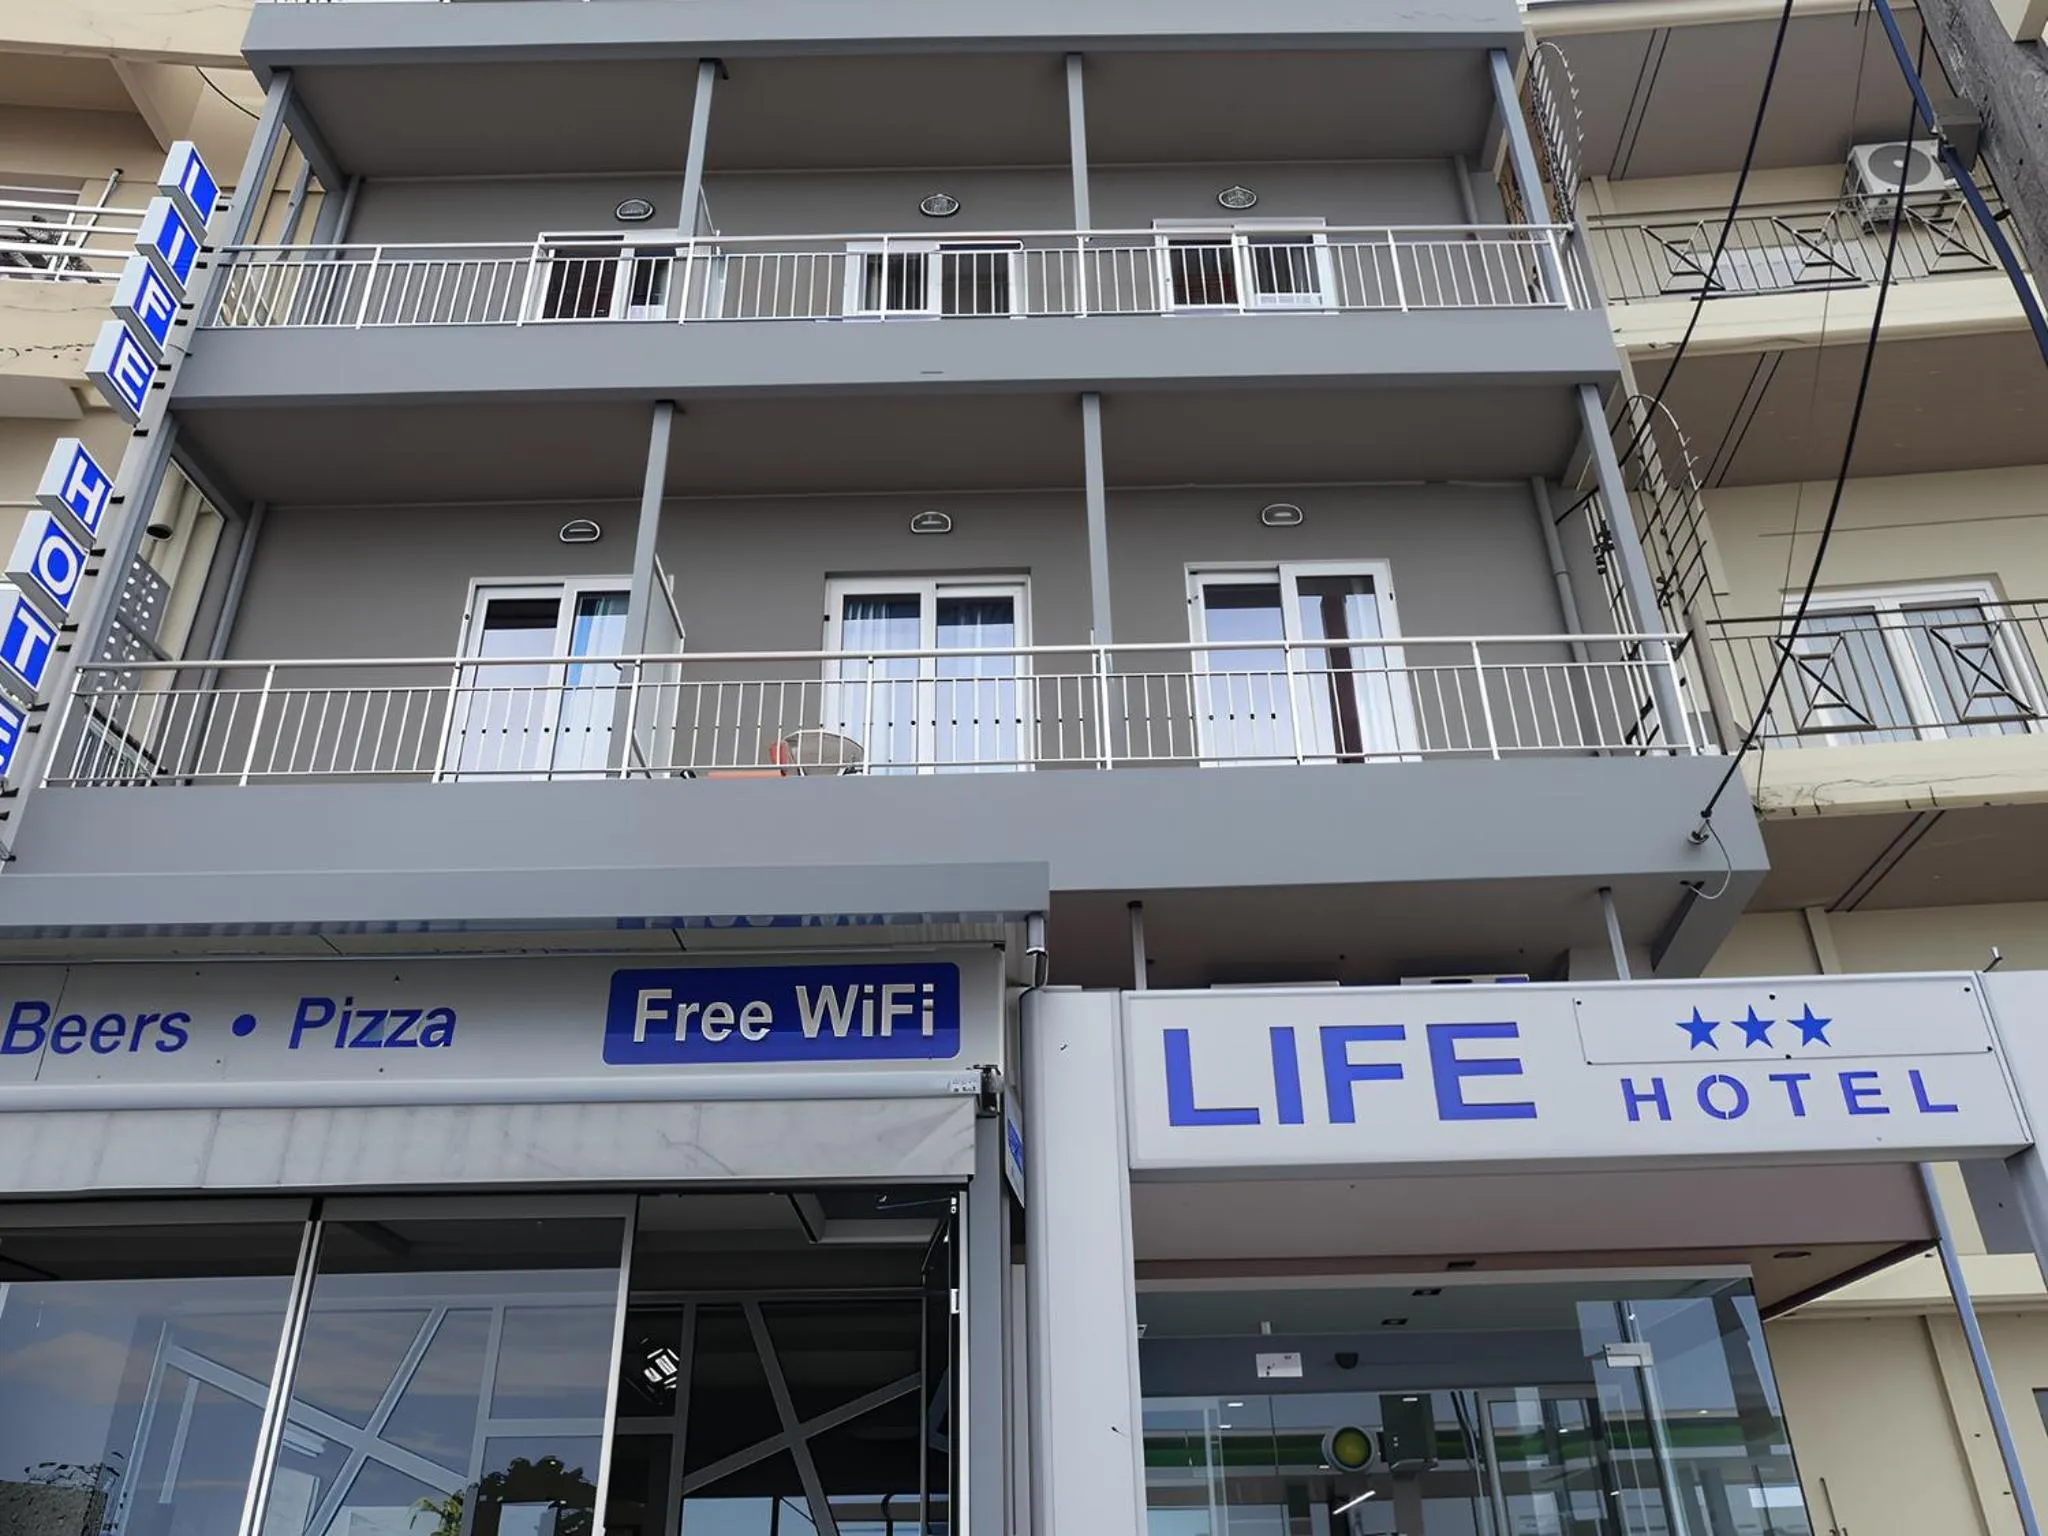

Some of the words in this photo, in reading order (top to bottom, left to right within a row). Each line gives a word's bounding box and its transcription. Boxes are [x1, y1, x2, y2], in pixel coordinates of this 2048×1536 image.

[0, 1000, 191, 1055] Beers
[288, 997, 457, 1049] Pizza
[633, 988, 773, 1042] Free
[795, 983, 935, 1038] WiFi
[1163, 1022, 1538, 1126] LIFE
[1620, 1069, 1959, 1122] HOTEL
